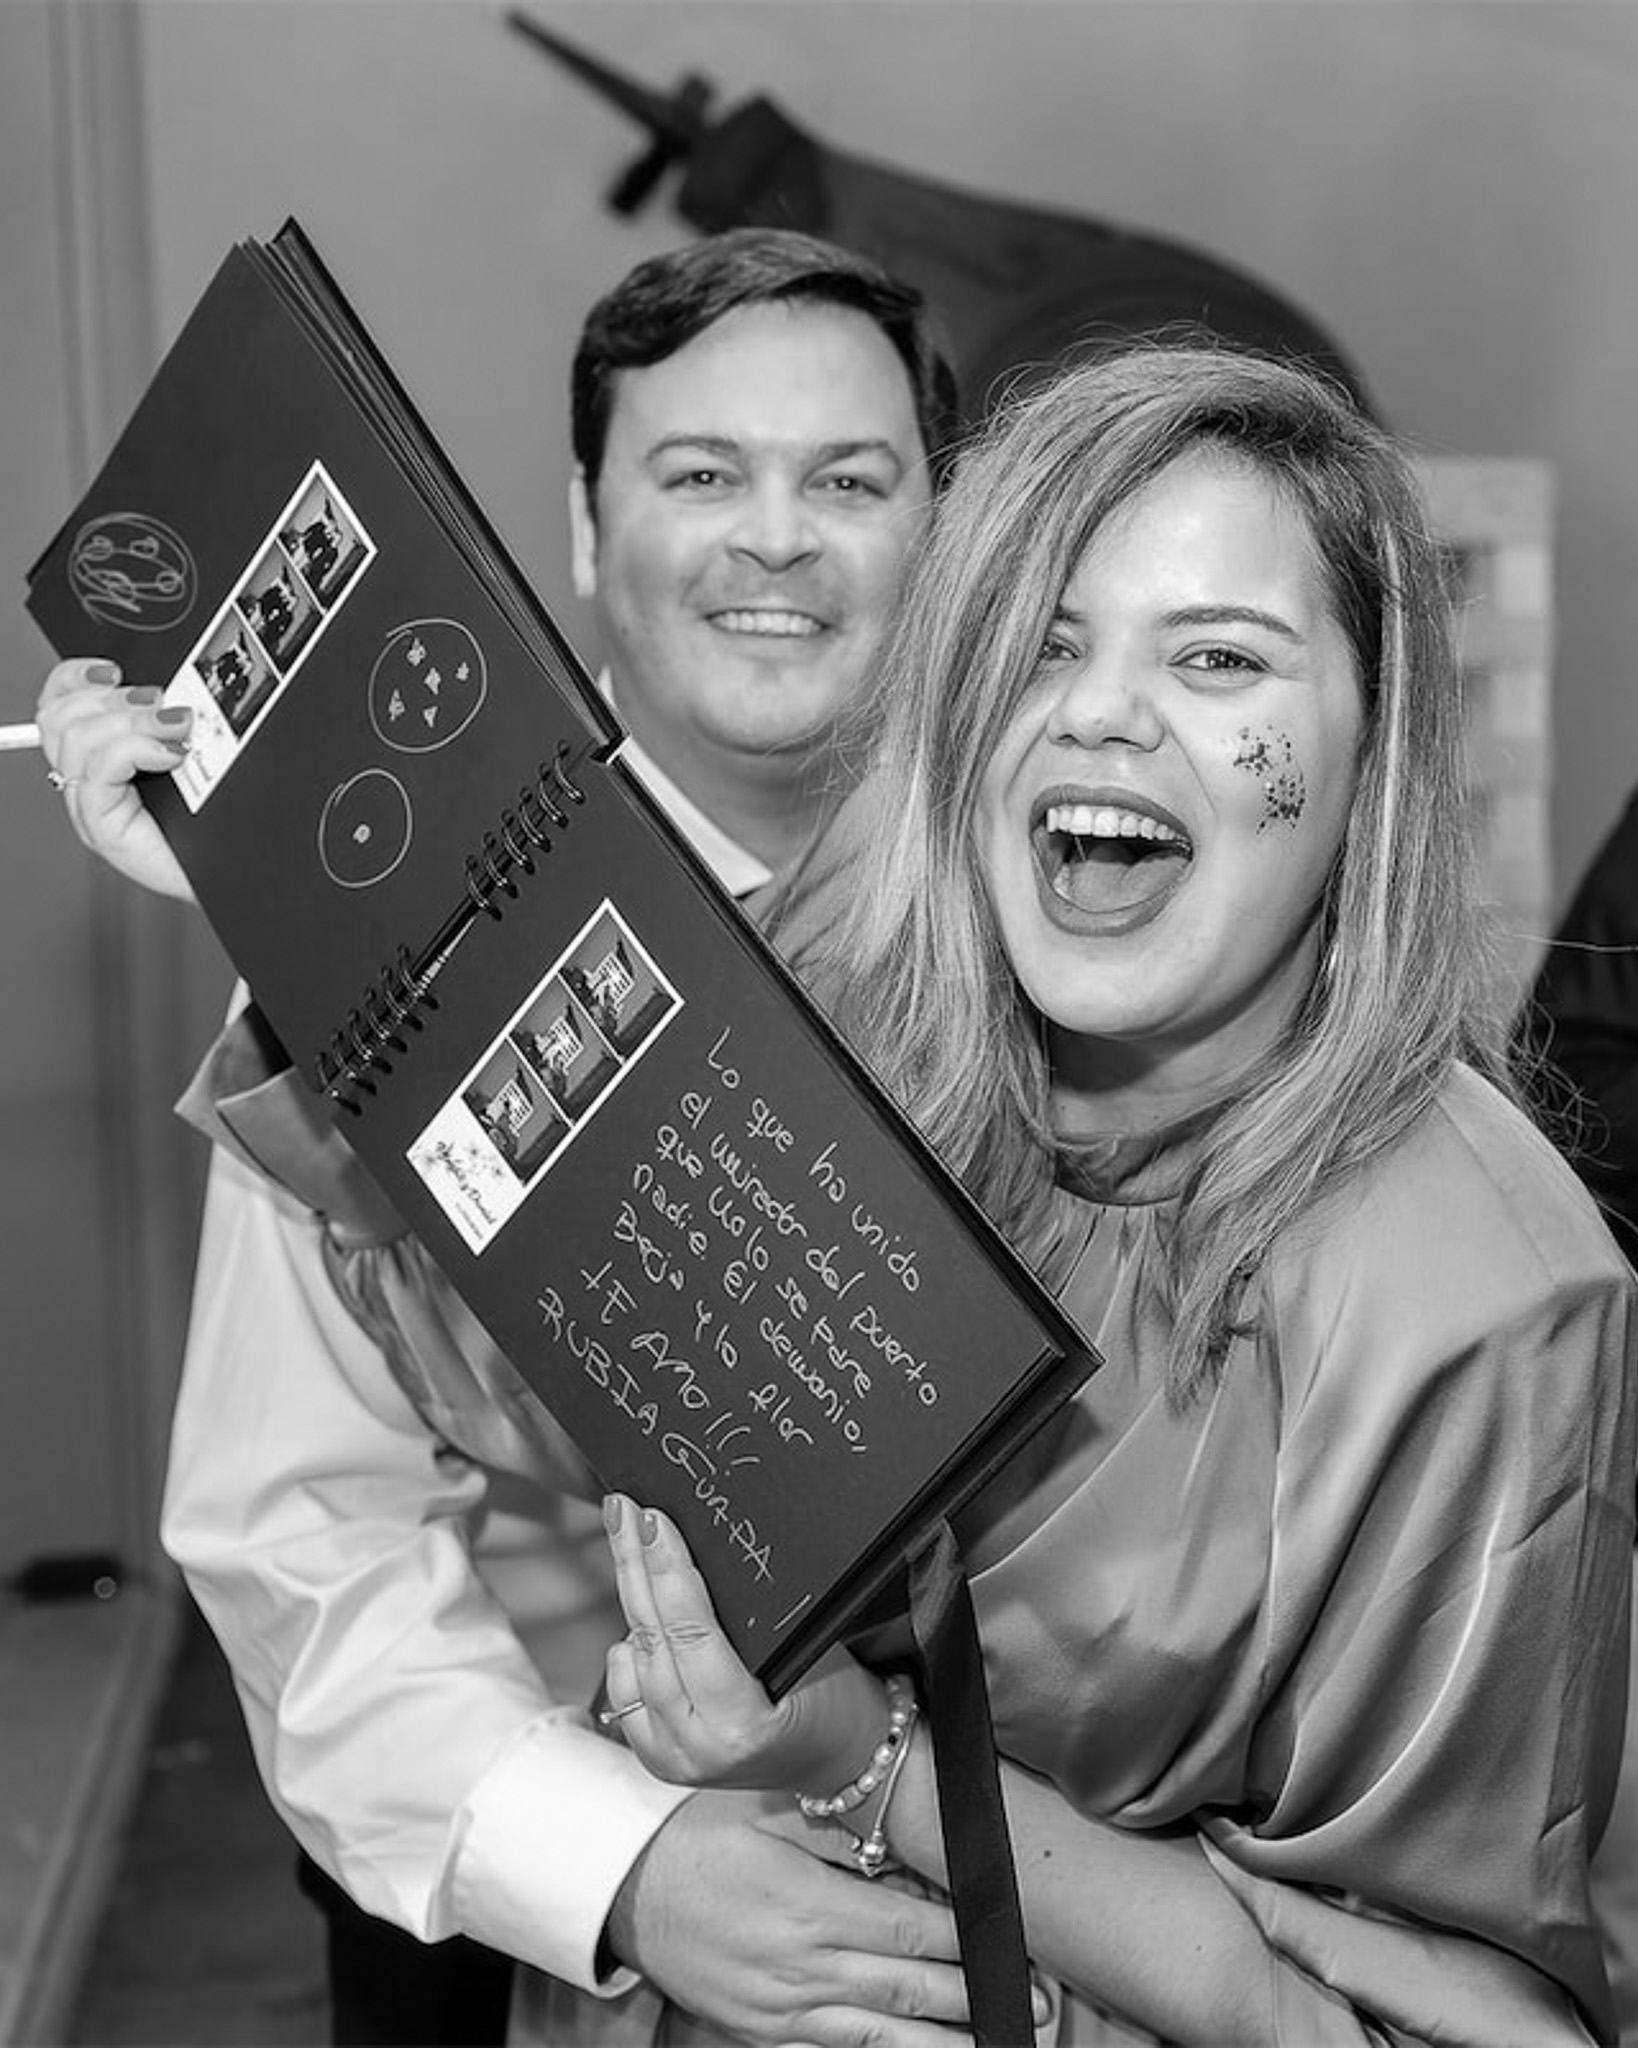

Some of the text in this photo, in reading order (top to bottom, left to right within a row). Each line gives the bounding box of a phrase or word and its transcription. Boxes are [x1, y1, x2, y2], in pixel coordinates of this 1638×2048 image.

[655, 1125, 704, 1179] que
[707, 1026, 740, 1089] Lo
[746, 1097, 794, 1153] que
[851, 1203, 920, 1292] unido
[537, 1287, 659, 1436] RUBIA
[805, 1245, 866, 1300] del
[849, 1305, 937, 1406] puerto
